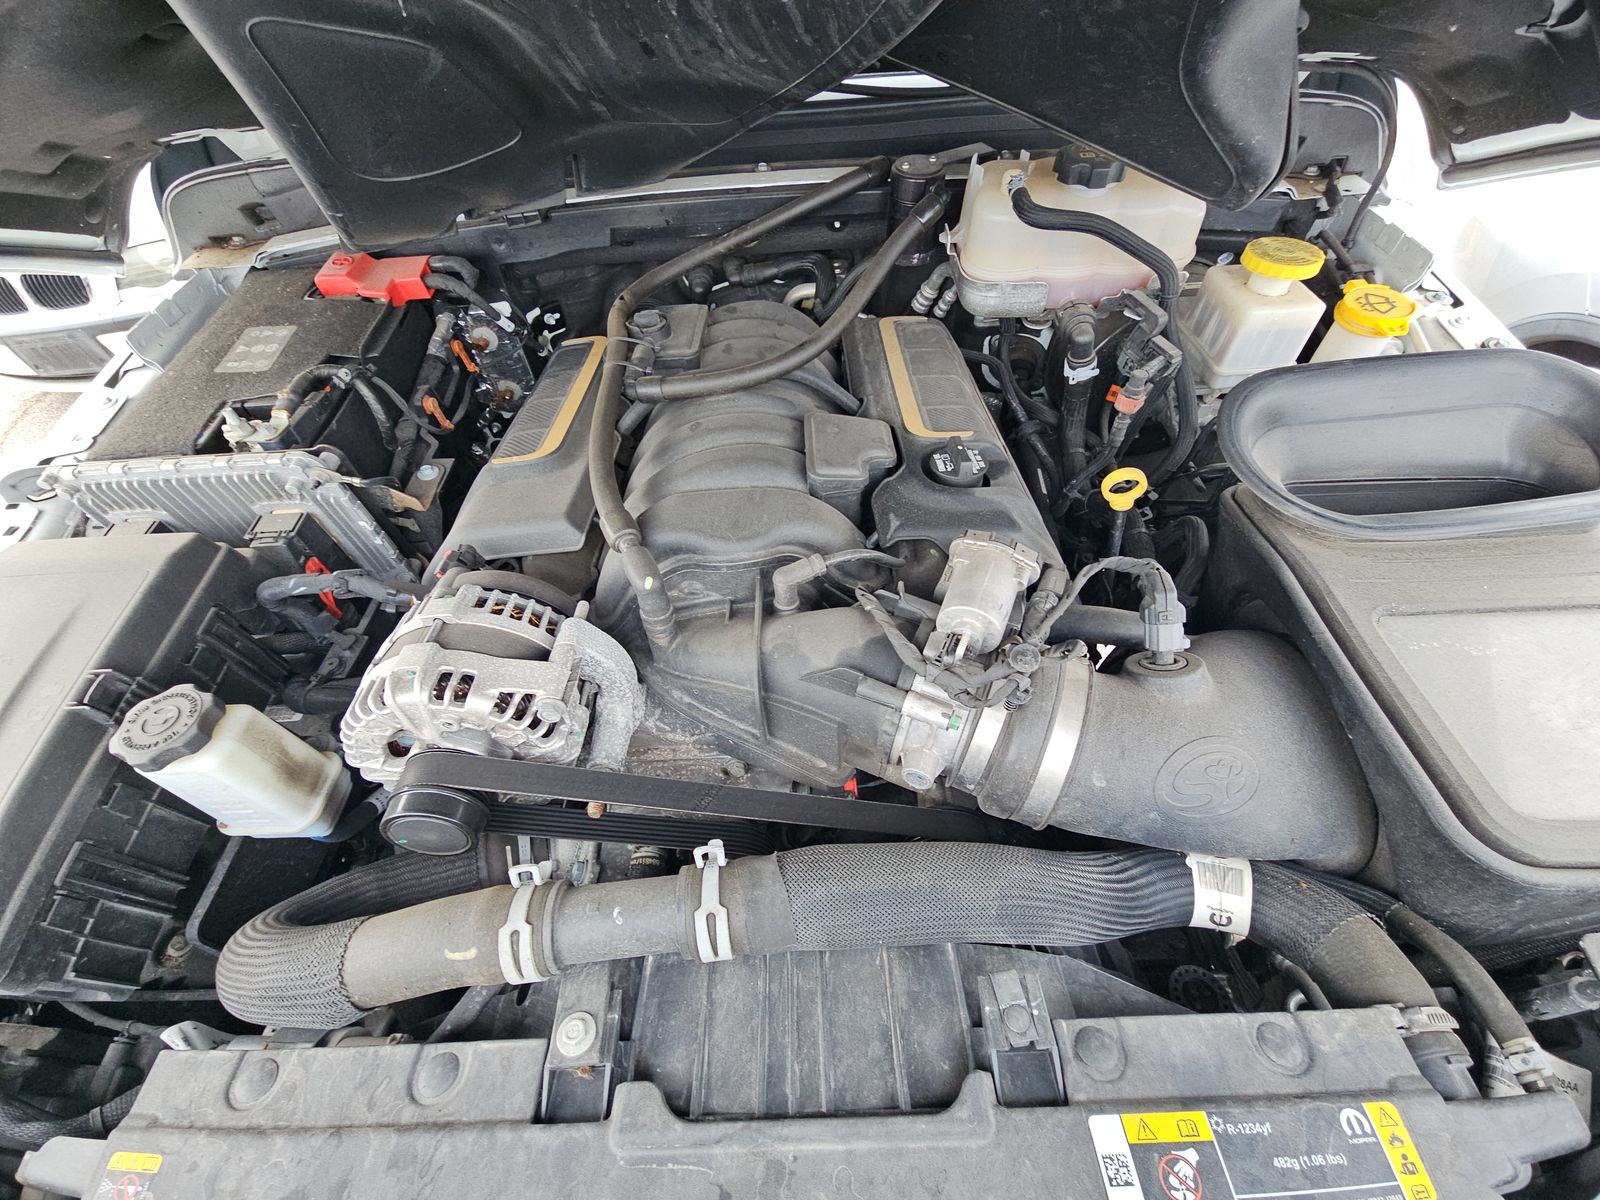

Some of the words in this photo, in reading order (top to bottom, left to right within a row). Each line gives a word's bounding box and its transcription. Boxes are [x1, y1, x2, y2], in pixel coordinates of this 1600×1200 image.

[1226, 1121, 1272, 1136] R-1234yf
[1273, 1156, 1300, 1171] 482g
[1300, 1154, 1326, 1170] (1.06
[1327, 1152, 1348, 1167] lbs)
